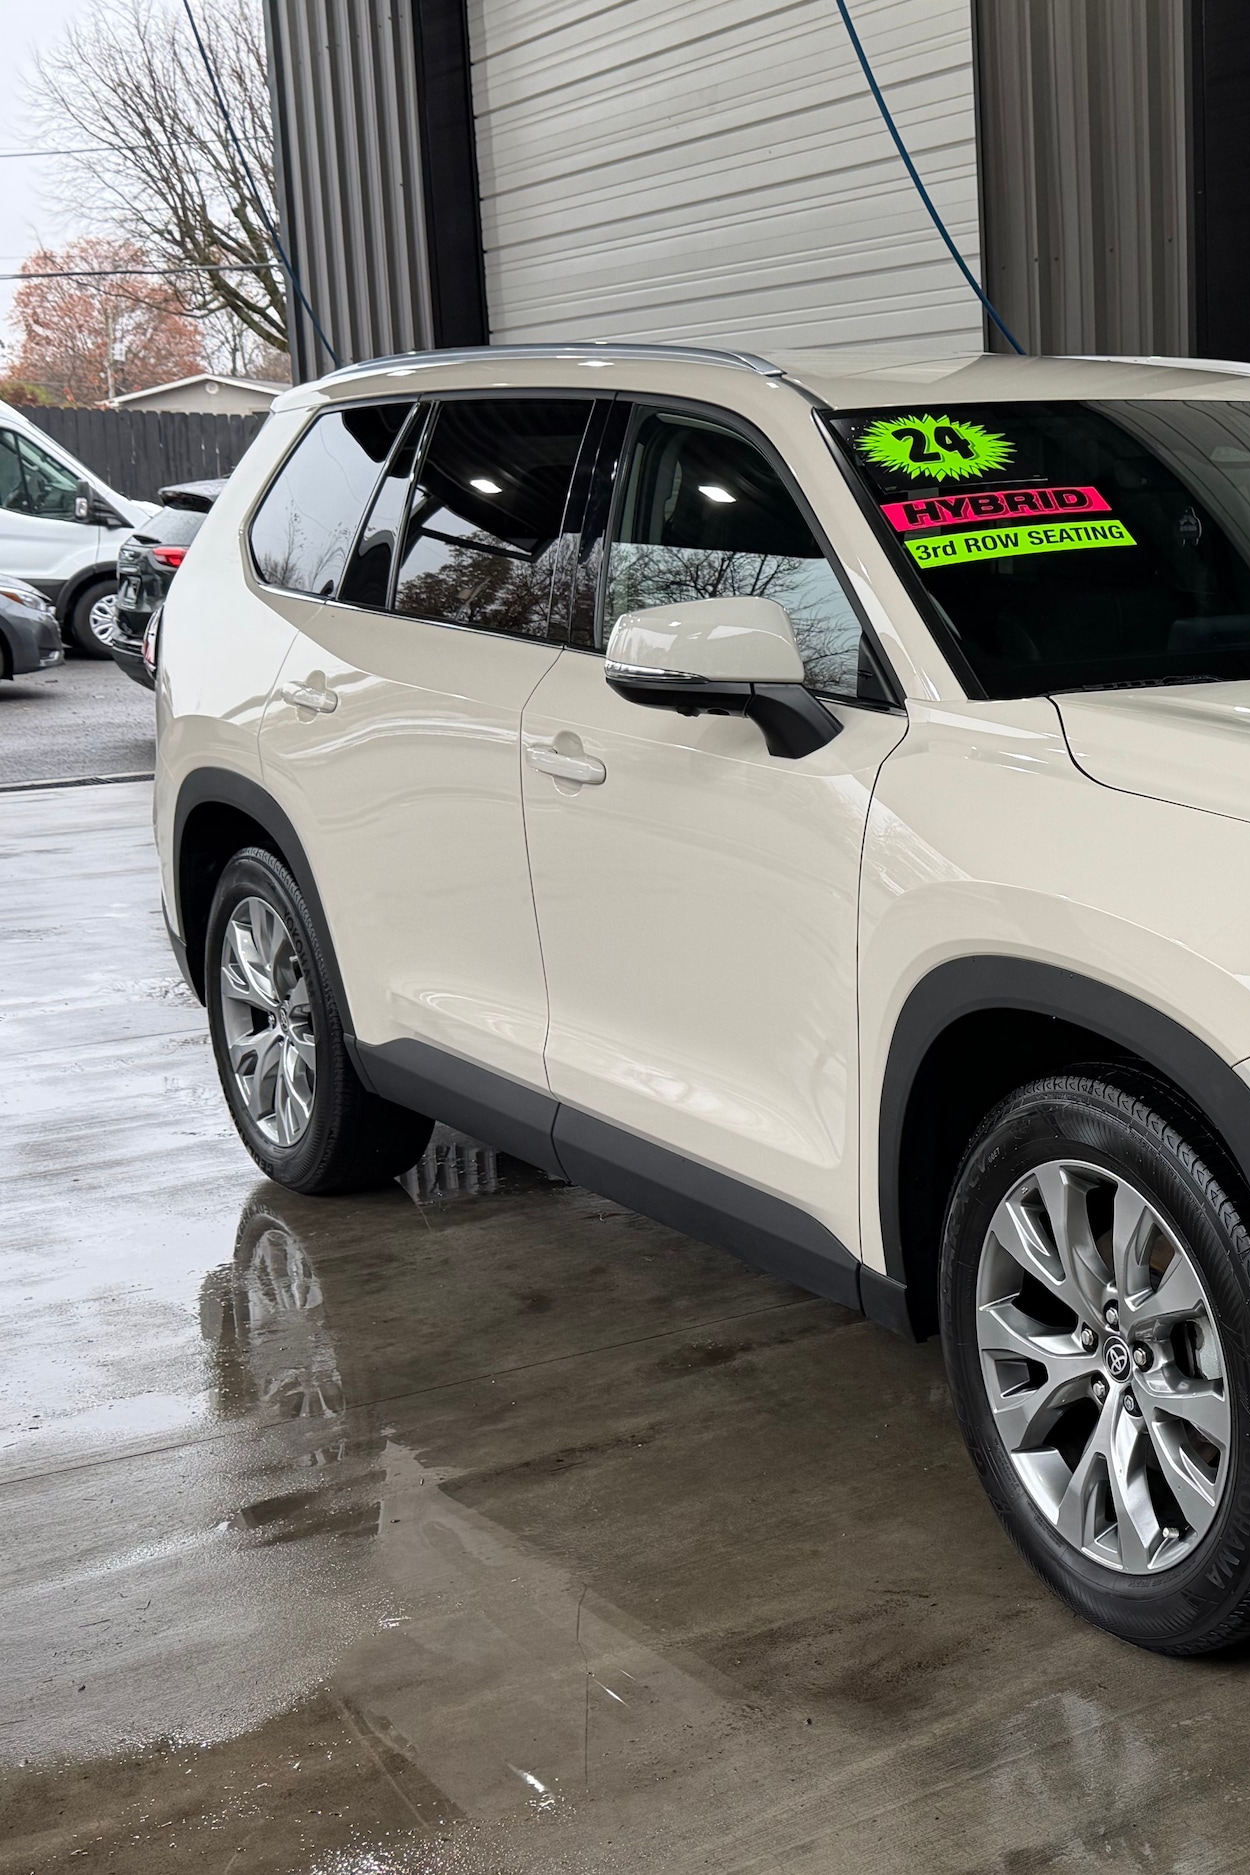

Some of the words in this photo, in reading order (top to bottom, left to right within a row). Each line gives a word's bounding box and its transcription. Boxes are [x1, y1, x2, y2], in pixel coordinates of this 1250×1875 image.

[891, 426, 976, 463] 24
[902, 489, 1092, 526] HYBRID
[915, 539, 957, 562] 3rd
[964, 532, 1020, 554] ROW
[1027, 524, 1125, 547] SEATING
